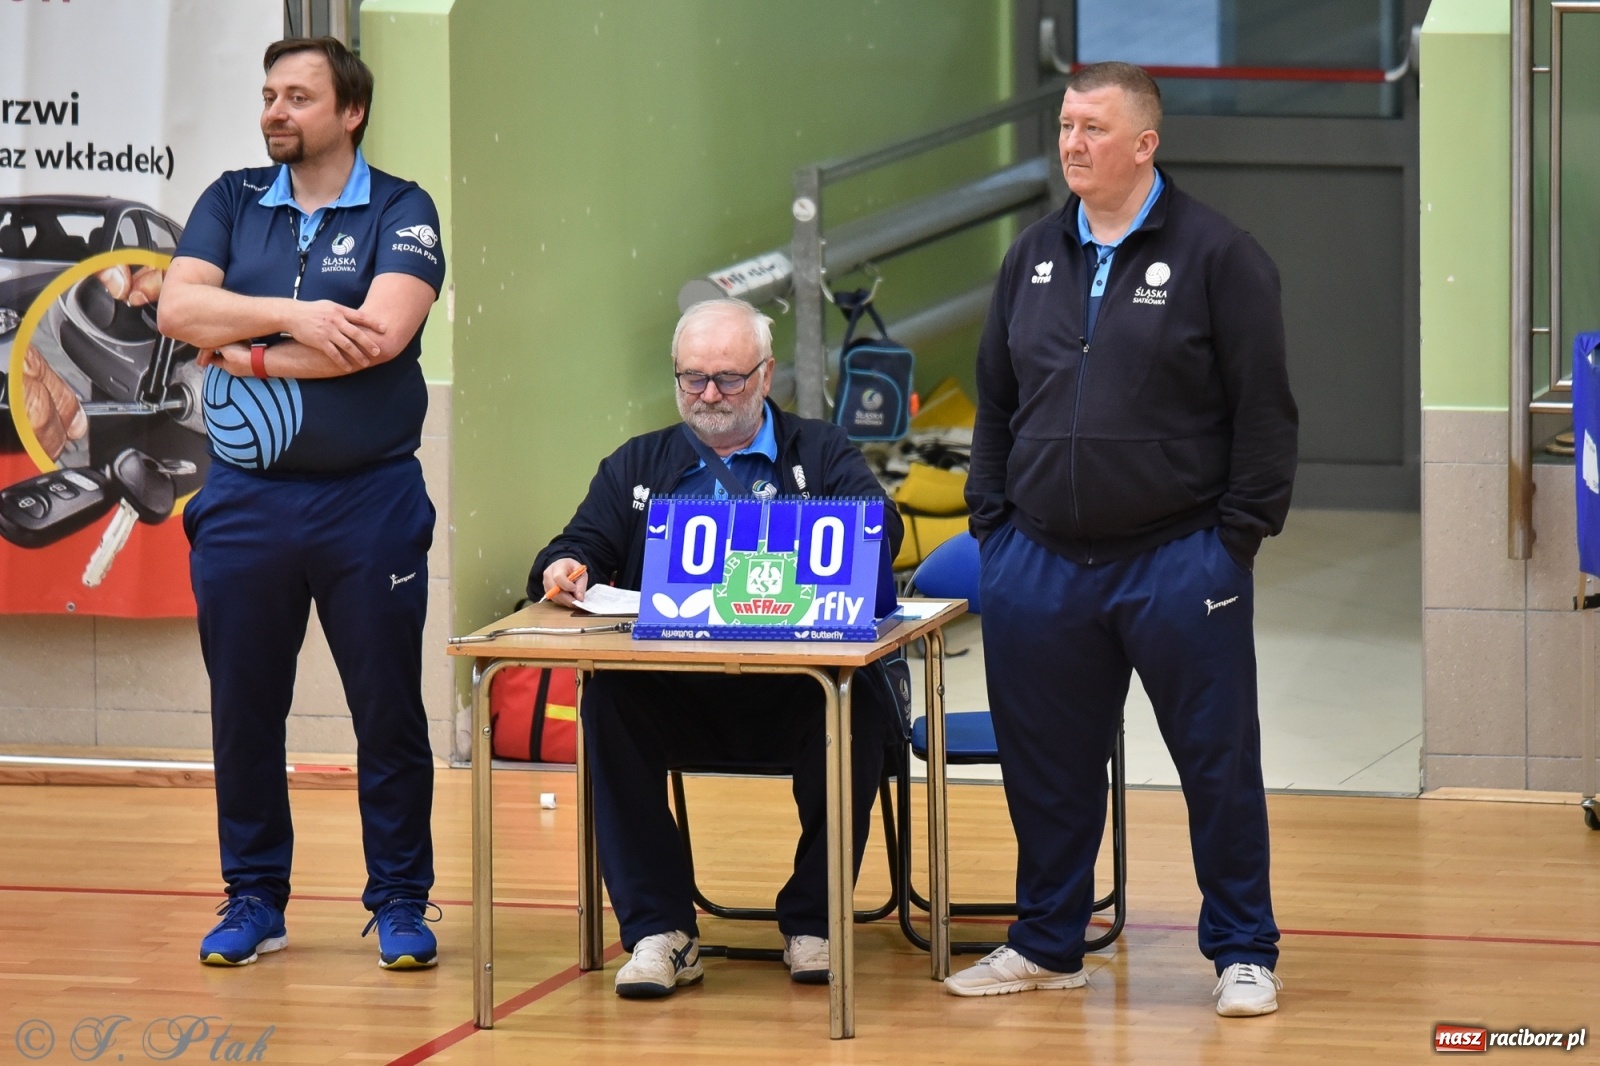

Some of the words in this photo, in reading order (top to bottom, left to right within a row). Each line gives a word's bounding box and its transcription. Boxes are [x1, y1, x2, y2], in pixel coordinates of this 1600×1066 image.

[35, 142, 174, 181] wkładek)
[392, 243, 422, 255] SĘDZIA
[322, 255, 356, 267] ŚLĄSKA
[321, 264, 356, 273] SIATKÓWKA
[1134, 286, 1167, 298] ŚLĄSKA
[681, 515, 718, 576] 0
[809, 516, 845, 577] 0
[661, 629, 694, 638] Butterfly
[811, 631, 844, 640] Butterfly
